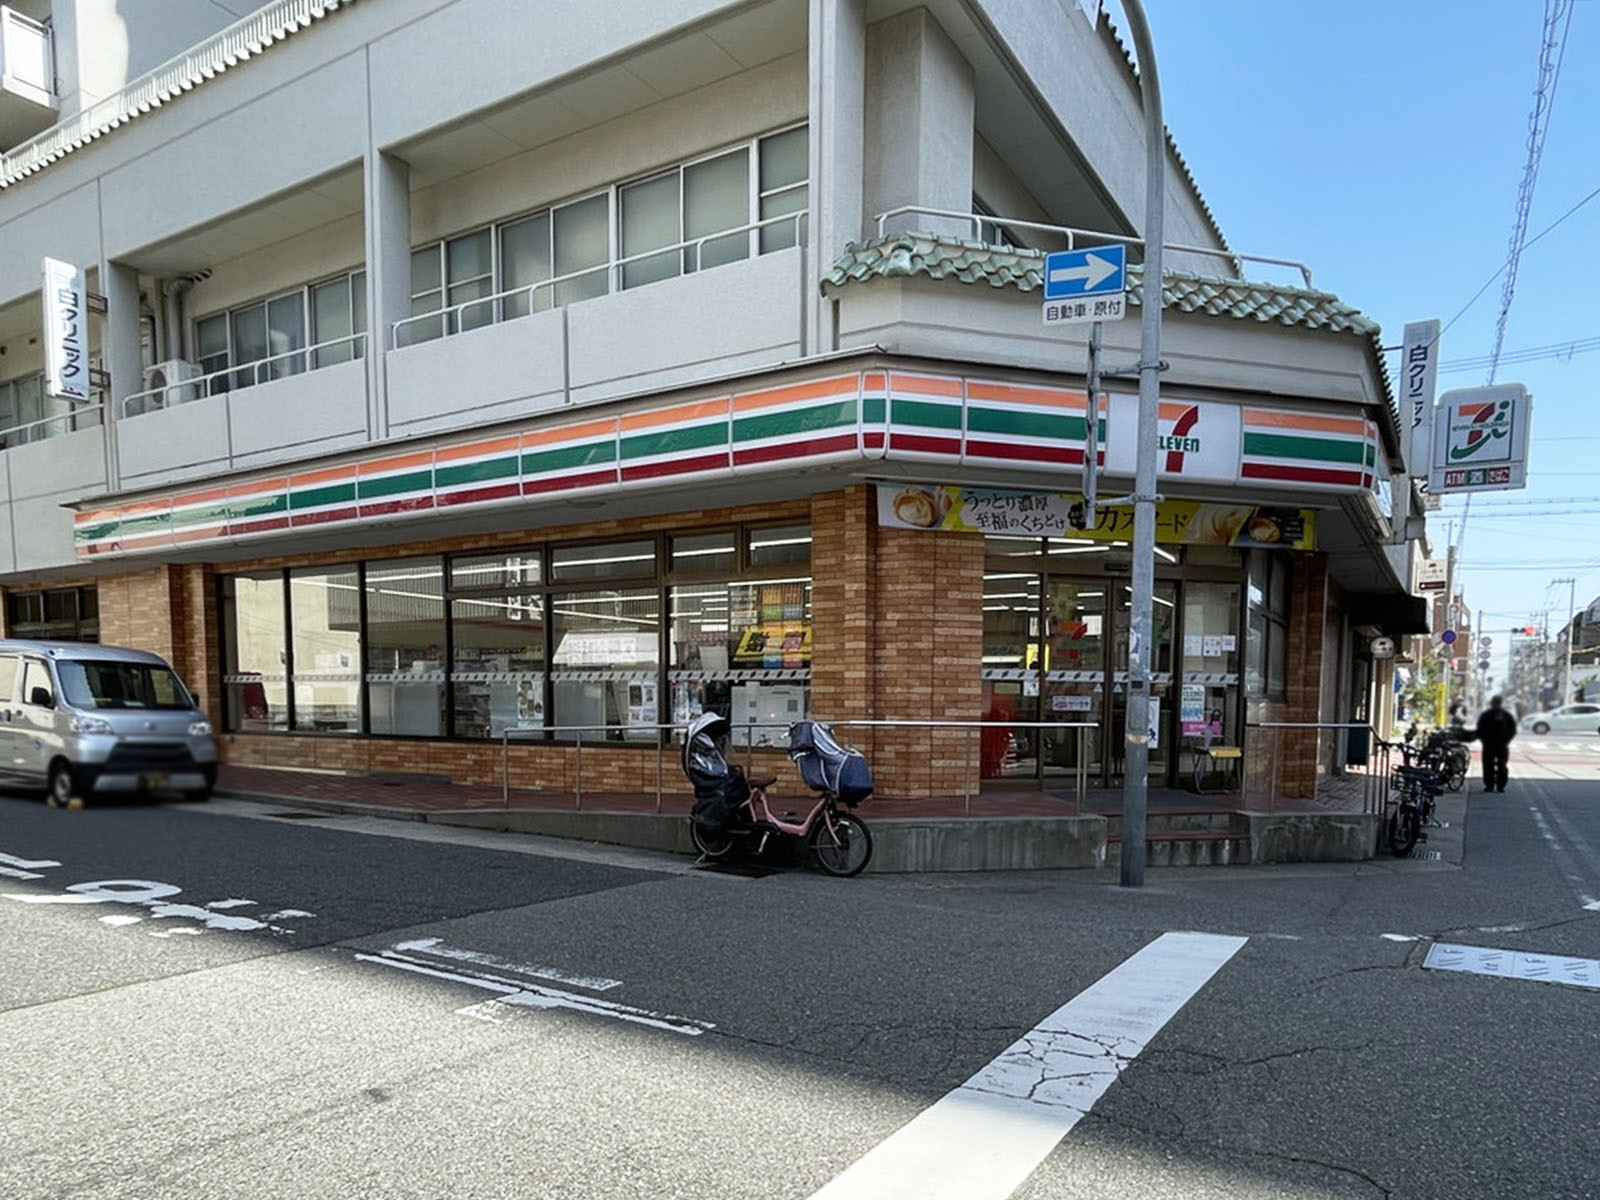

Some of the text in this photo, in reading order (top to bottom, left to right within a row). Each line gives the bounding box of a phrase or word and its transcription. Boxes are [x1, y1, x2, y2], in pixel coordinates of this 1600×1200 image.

[1047, 300, 1121, 321] 自動車・原付
[1408, 344, 1428, 429] 白クリニック
[1446, 472, 1465, 486] ATM
[964, 491, 1048, 512] うっとり濃厚
